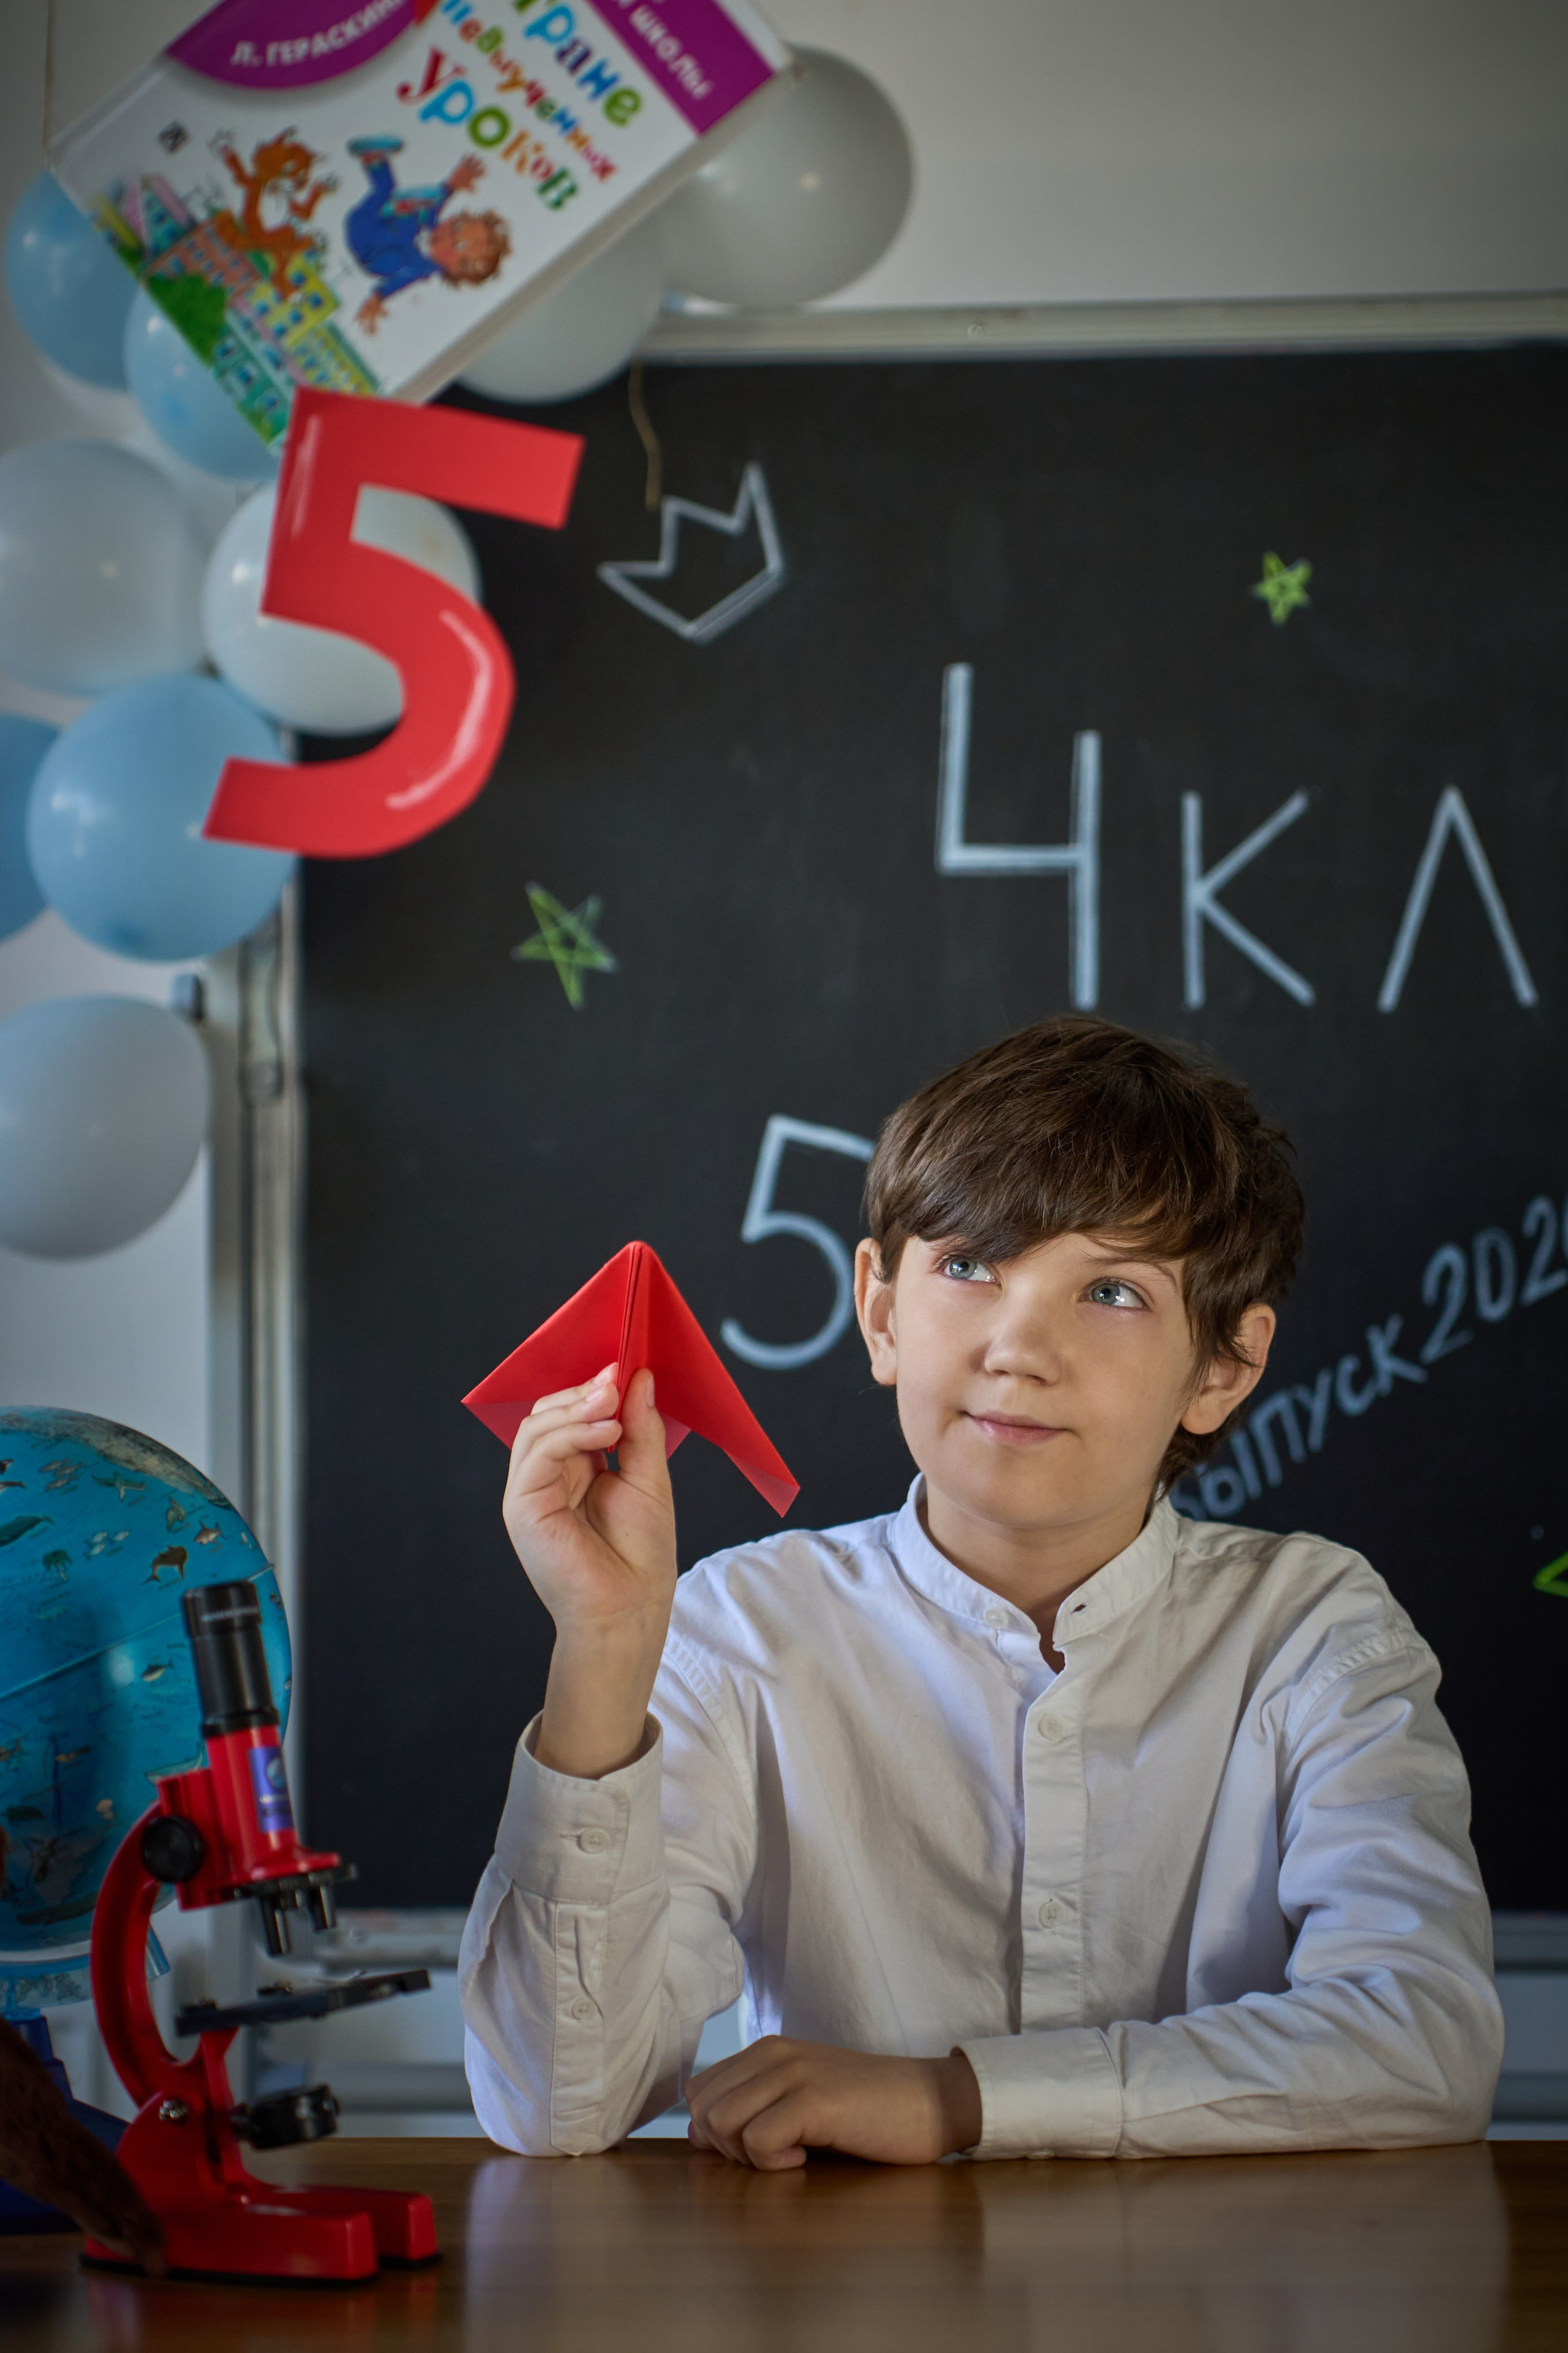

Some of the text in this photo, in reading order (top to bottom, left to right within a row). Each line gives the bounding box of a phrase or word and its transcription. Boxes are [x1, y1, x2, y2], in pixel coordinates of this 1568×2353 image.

[201, 384, 587, 859] 5
[936, 662, 1102, 1011] 4
[1419, 1193, 1568, 1366] 202
